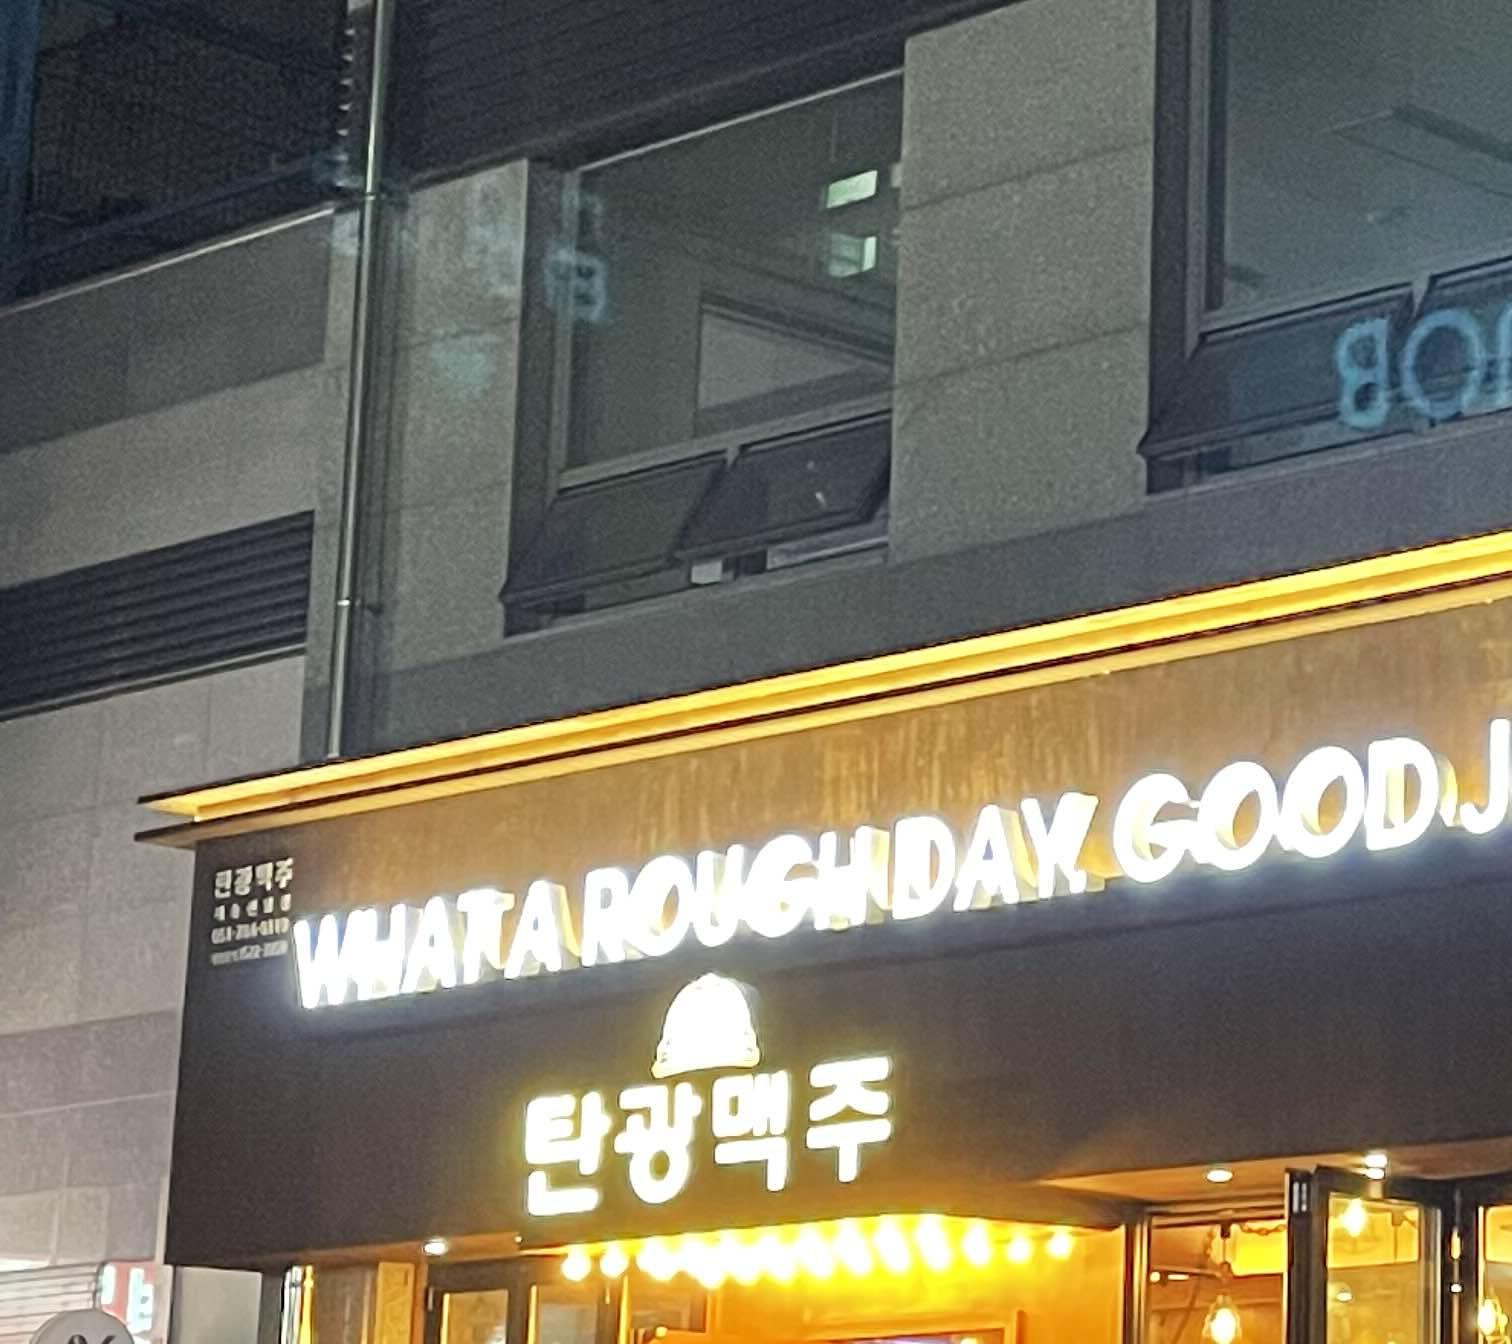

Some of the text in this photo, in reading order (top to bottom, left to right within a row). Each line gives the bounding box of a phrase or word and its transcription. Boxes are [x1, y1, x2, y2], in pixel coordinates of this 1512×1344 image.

[293, 888, 512, 1009] WHAT
[503, 880, 566, 980] A
[581, 824, 876, 967] ROUGH
[892, 791, 1099, 920] DAY
[1113, 736, 1441, 883] GOOD
[523, 1056, 893, 1218] 탄광맥주
